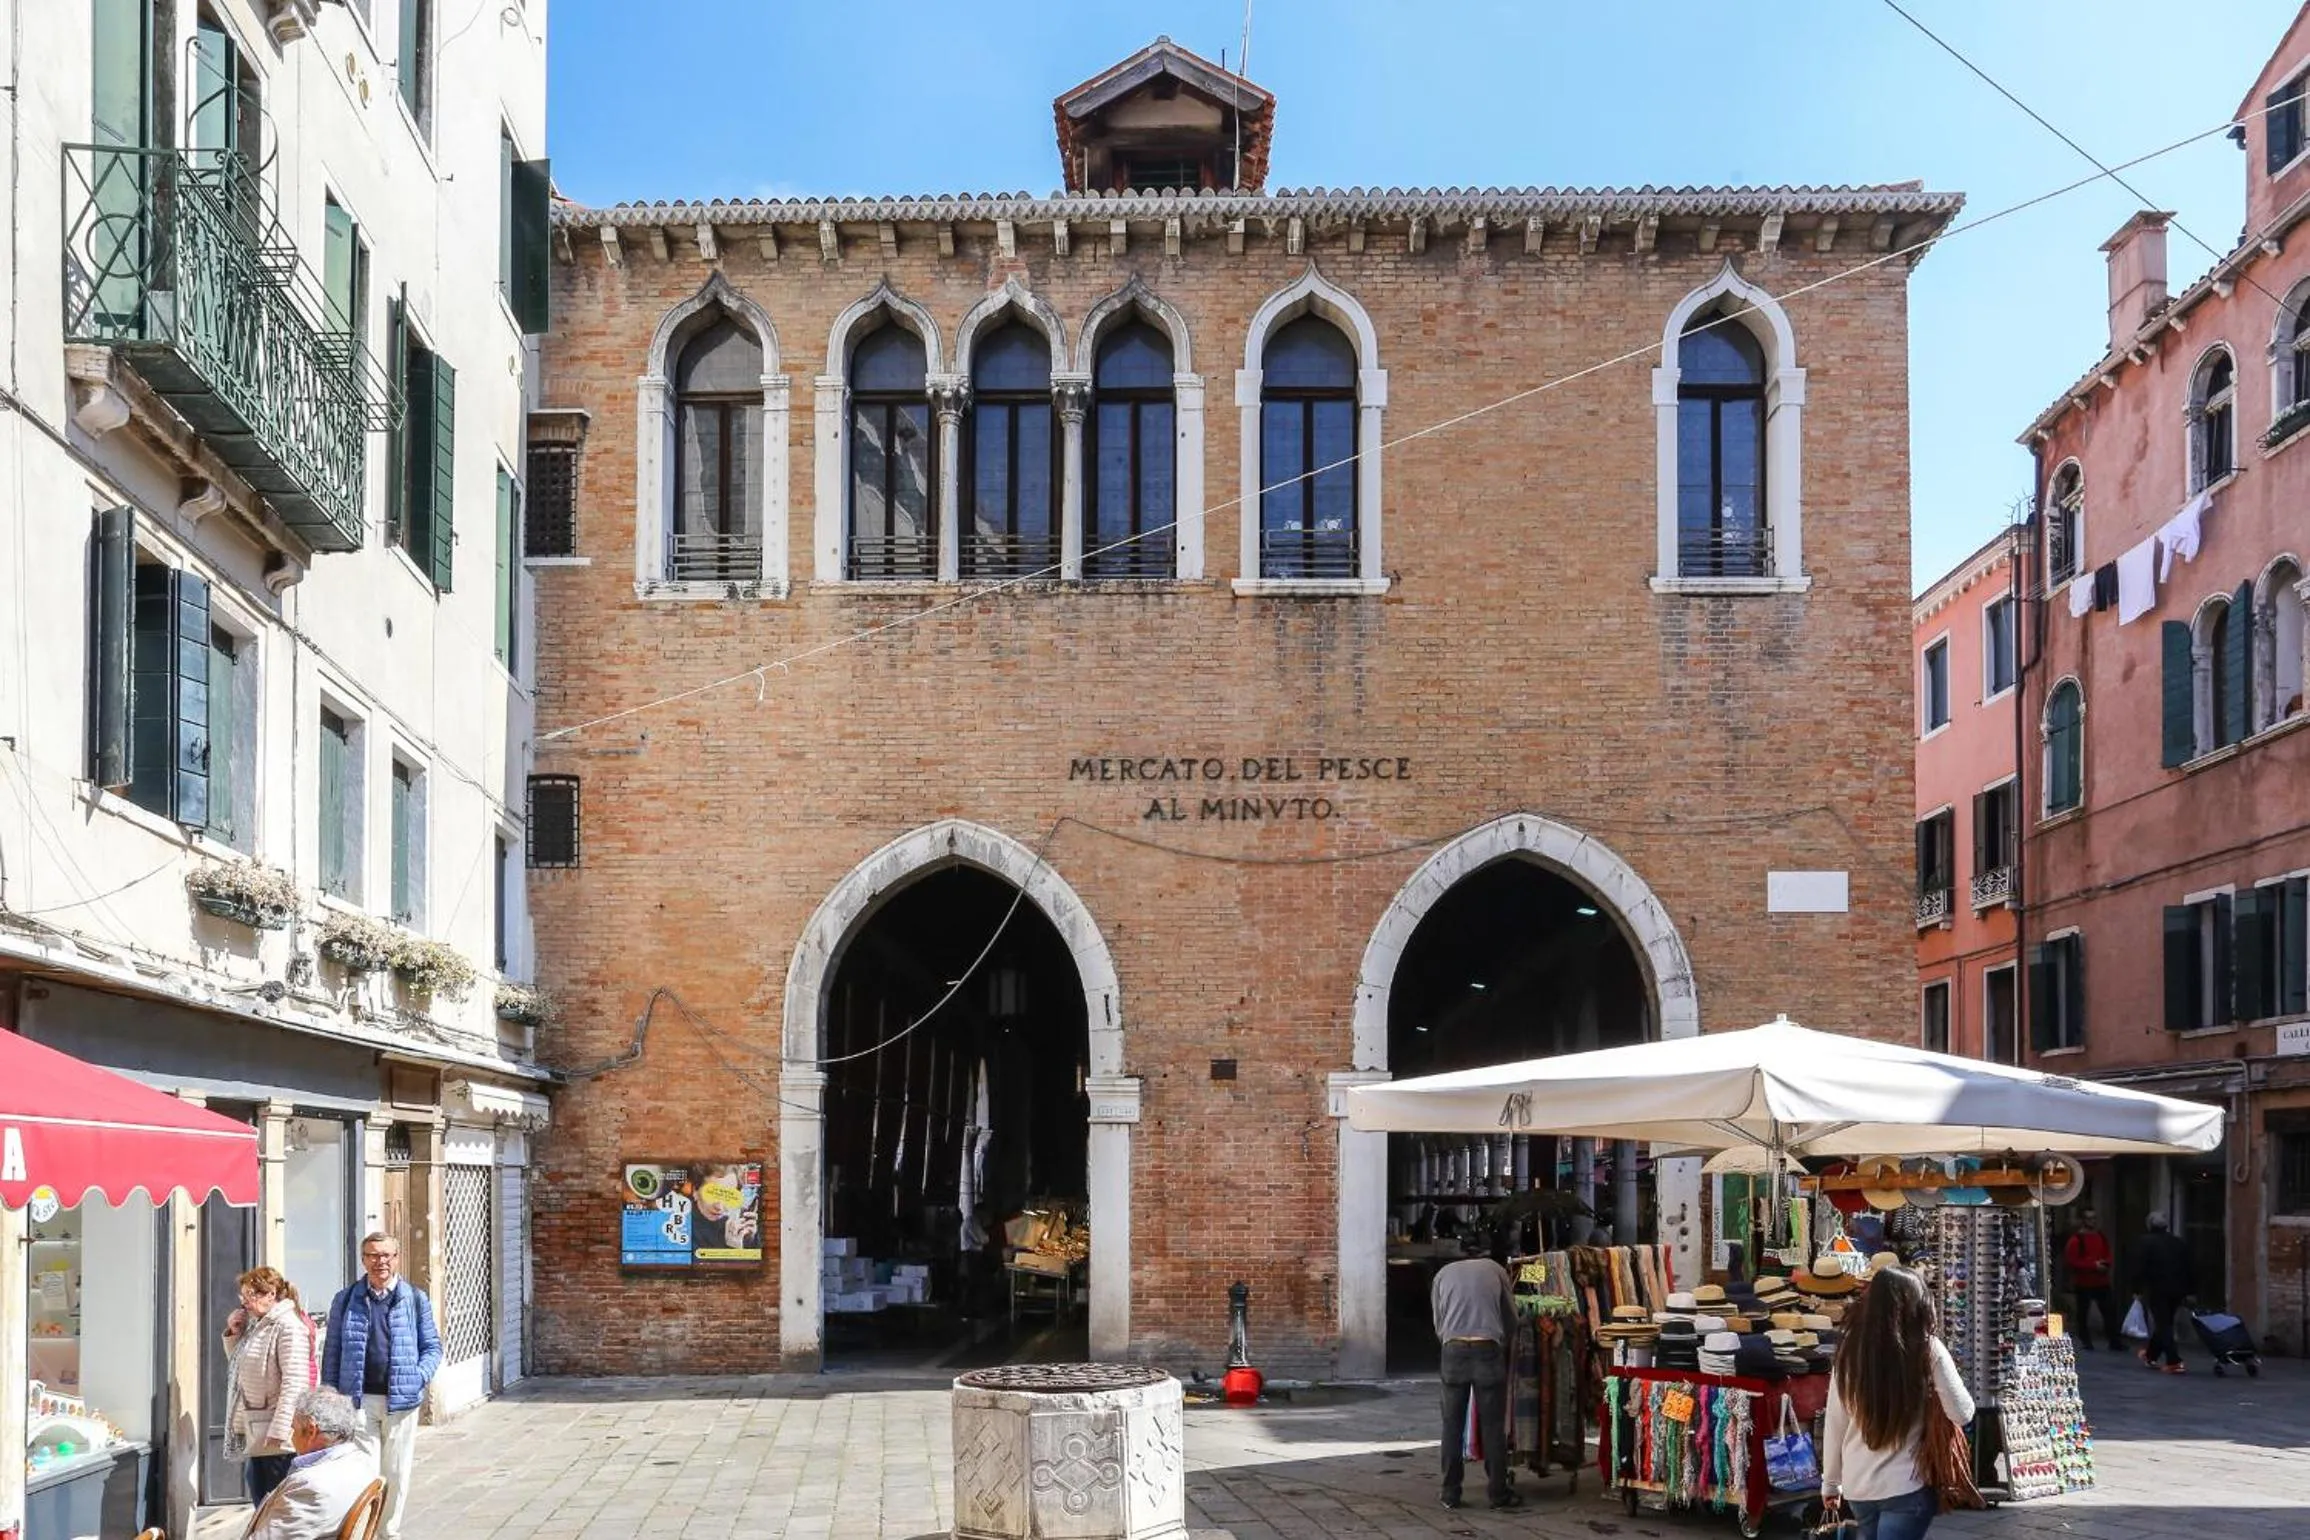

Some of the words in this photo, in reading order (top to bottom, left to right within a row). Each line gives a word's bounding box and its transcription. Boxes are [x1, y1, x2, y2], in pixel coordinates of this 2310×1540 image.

[1242, 757, 1302, 781] DEL
[1318, 757, 1412, 781] PESCE
[1143, 799, 1187, 821] AL
